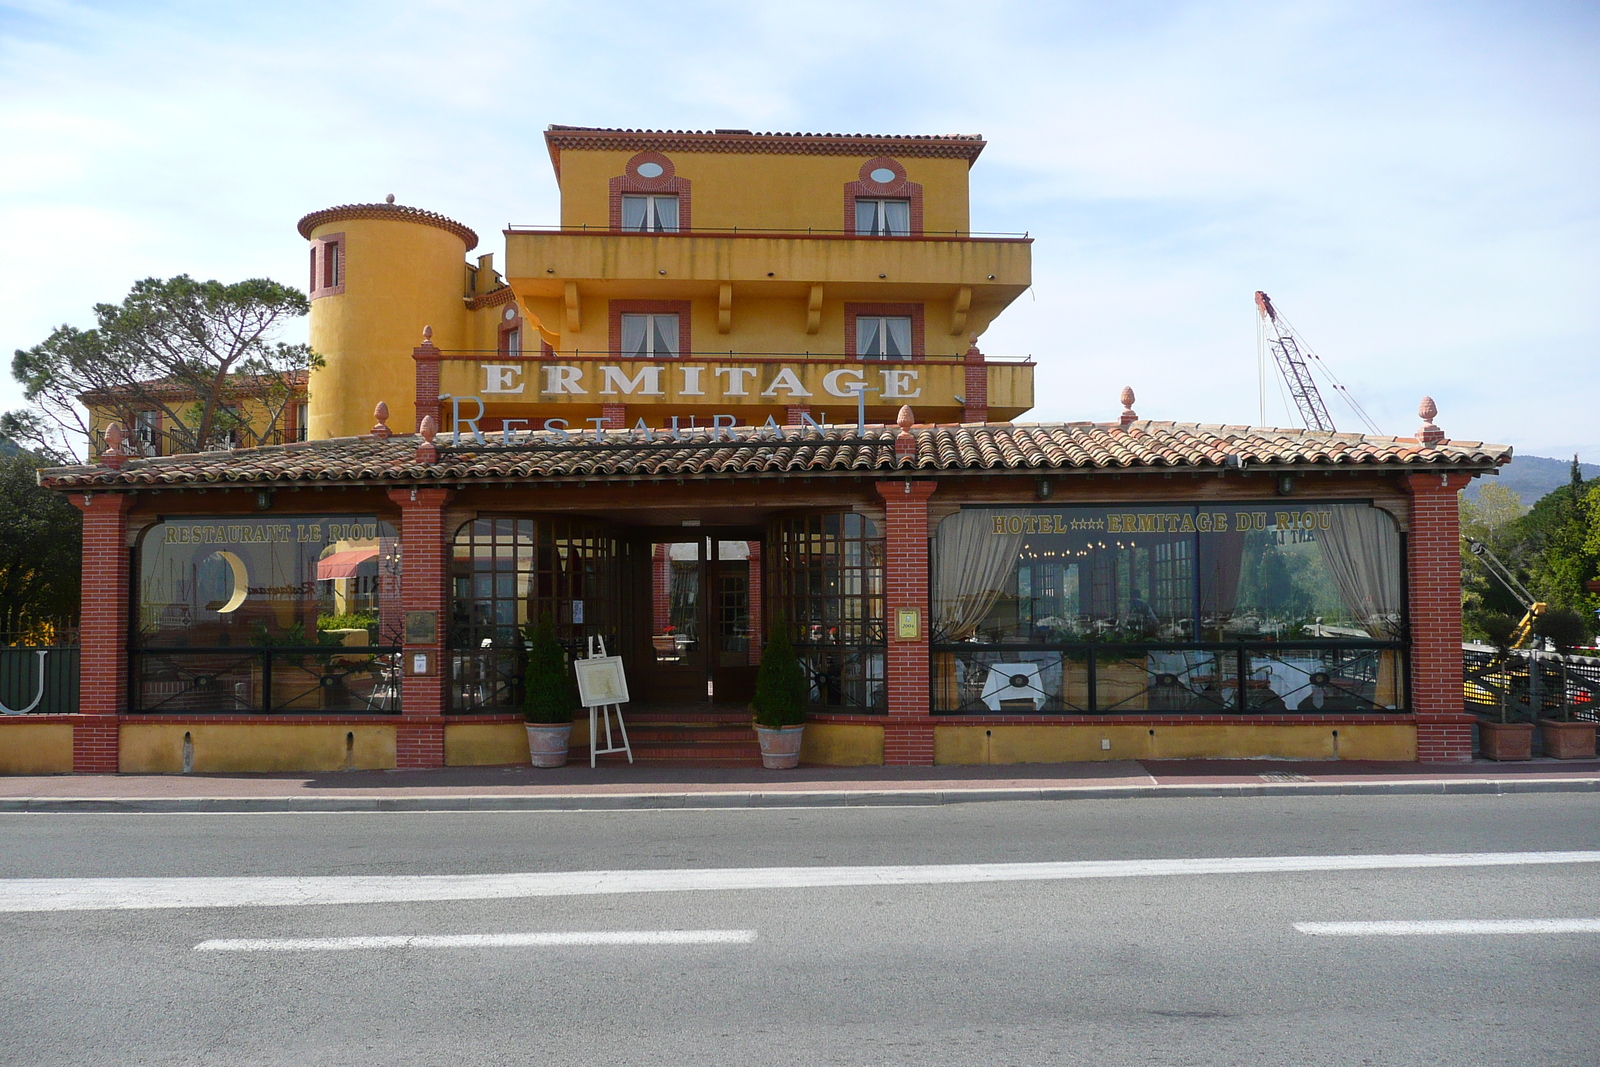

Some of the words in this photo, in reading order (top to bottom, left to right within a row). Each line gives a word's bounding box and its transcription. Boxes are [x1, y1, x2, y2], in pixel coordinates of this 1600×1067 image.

[480, 363, 922, 398] ERMITAGE
[451, 387, 880, 447] RESTAURANT
[164, 524, 292, 545] RESTAURANT
[296, 523, 322, 542] LE
[329, 522, 378, 542] RIOU
[991, 513, 1068, 535] HOTEL
[1106, 511, 1229, 533] ERMITAGE
[1235, 511, 1268, 531] DU
[1275, 510, 1333, 531] RIOU
